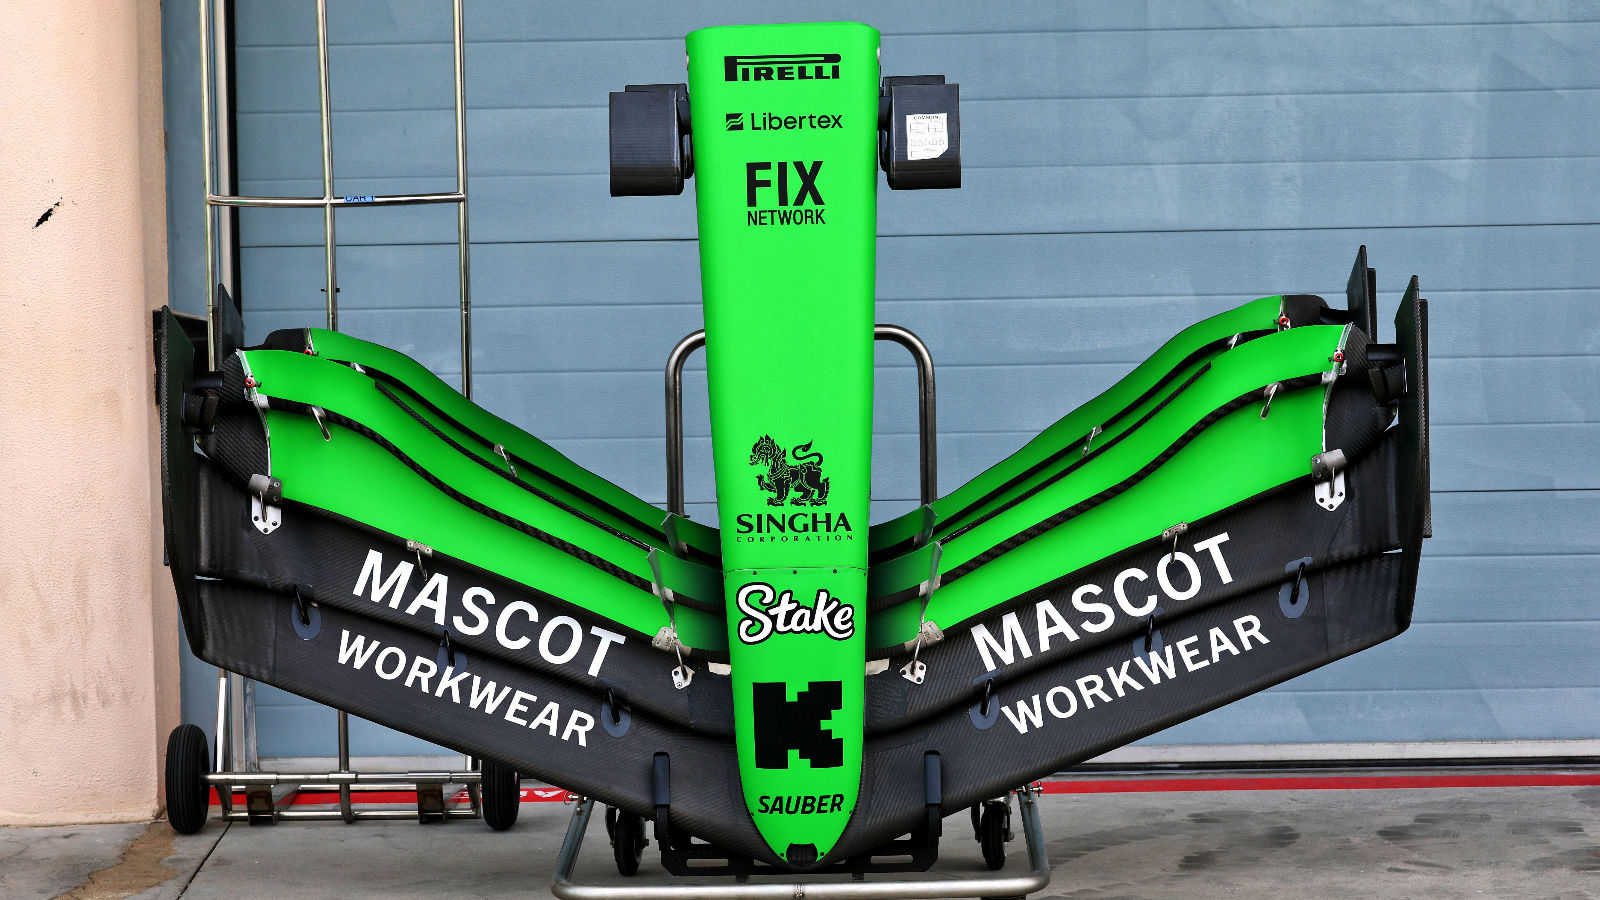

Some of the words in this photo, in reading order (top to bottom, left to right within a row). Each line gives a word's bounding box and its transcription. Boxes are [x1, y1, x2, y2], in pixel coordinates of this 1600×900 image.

[724, 54, 842, 81] PIRELLI
[751, 112, 844, 131] Libertex
[746, 160, 826, 207] FIX
[747, 208, 826, 226] NETWORK
[736, 512, 853, 534] SINGHA
[736, 534, 854, 543] CORPORATION
[353, 549, 626, 677] MASCOT
[736, 582, 855, 645] Stake
[971, 532, 1233, 672] MASCOT
[338, 629, 595, 747] WORKWEAR
[1001, 615, 1270, 734] WORKWEAR
[753, 680, 844, 770] K
[758, 794, 844, 815] SAUBER
